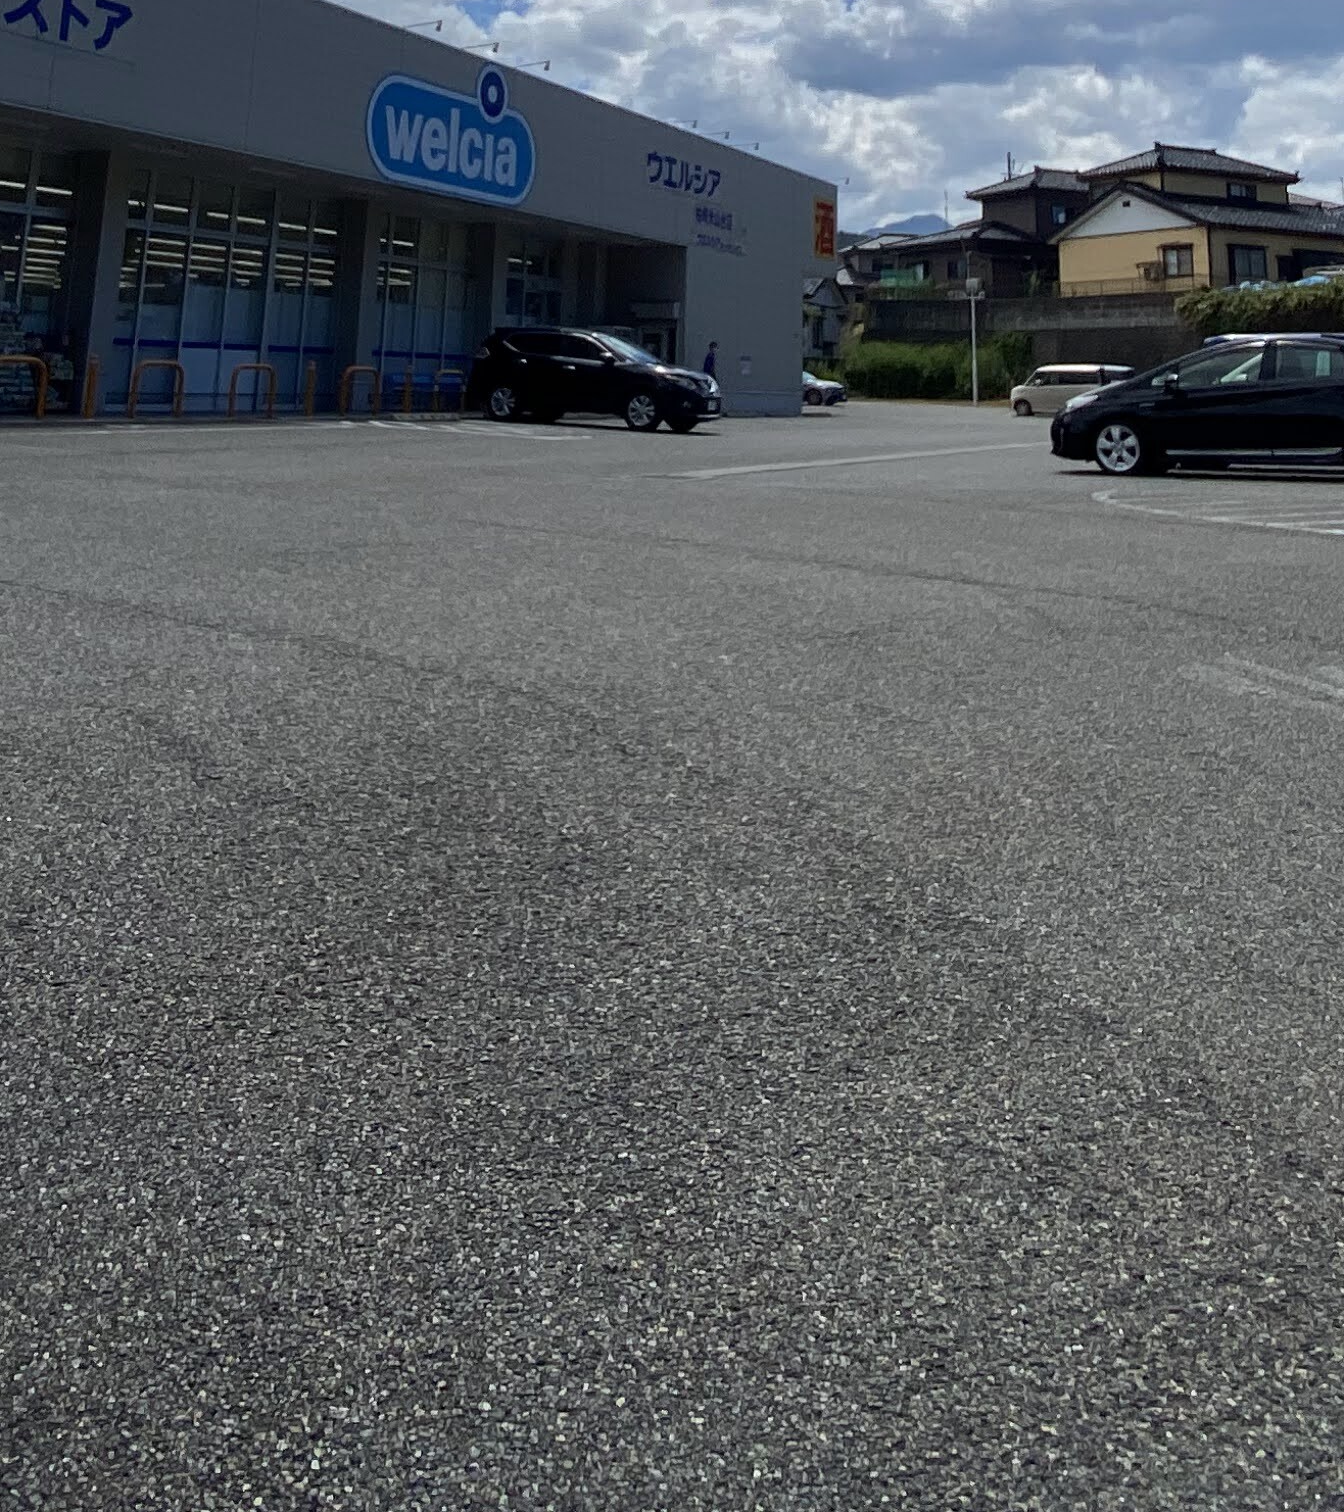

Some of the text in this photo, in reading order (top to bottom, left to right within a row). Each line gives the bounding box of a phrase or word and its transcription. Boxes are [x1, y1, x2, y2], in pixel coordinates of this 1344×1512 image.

[385, 68, 516, 188] welcia
[646, 151, 722, 198] ウエルシア
